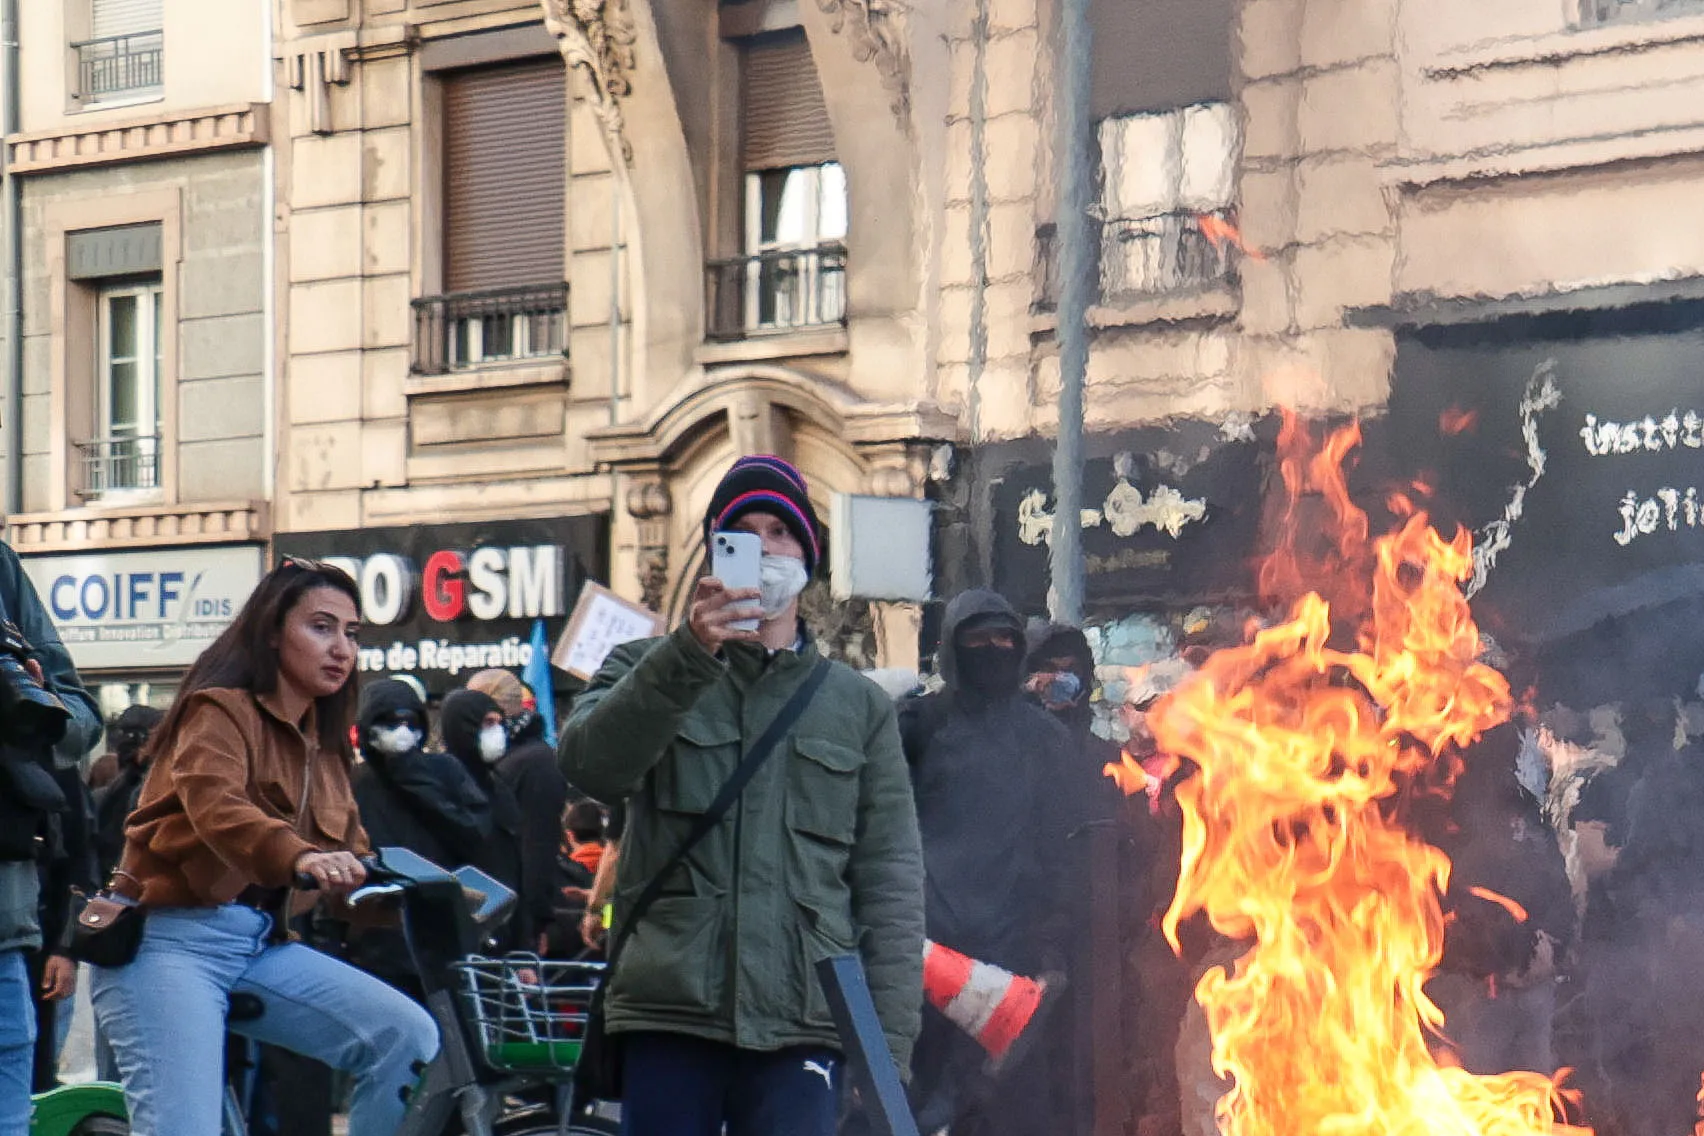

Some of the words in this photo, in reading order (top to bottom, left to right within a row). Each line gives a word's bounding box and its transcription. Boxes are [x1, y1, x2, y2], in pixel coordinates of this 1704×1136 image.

[51, 572, 183, 621] COIFF
[321, 552, 402, 625] O
[423, 545, 561, 622] GSM
[387, 641, 417, 671] de
[418, 637, 533, 675] Réparatio
